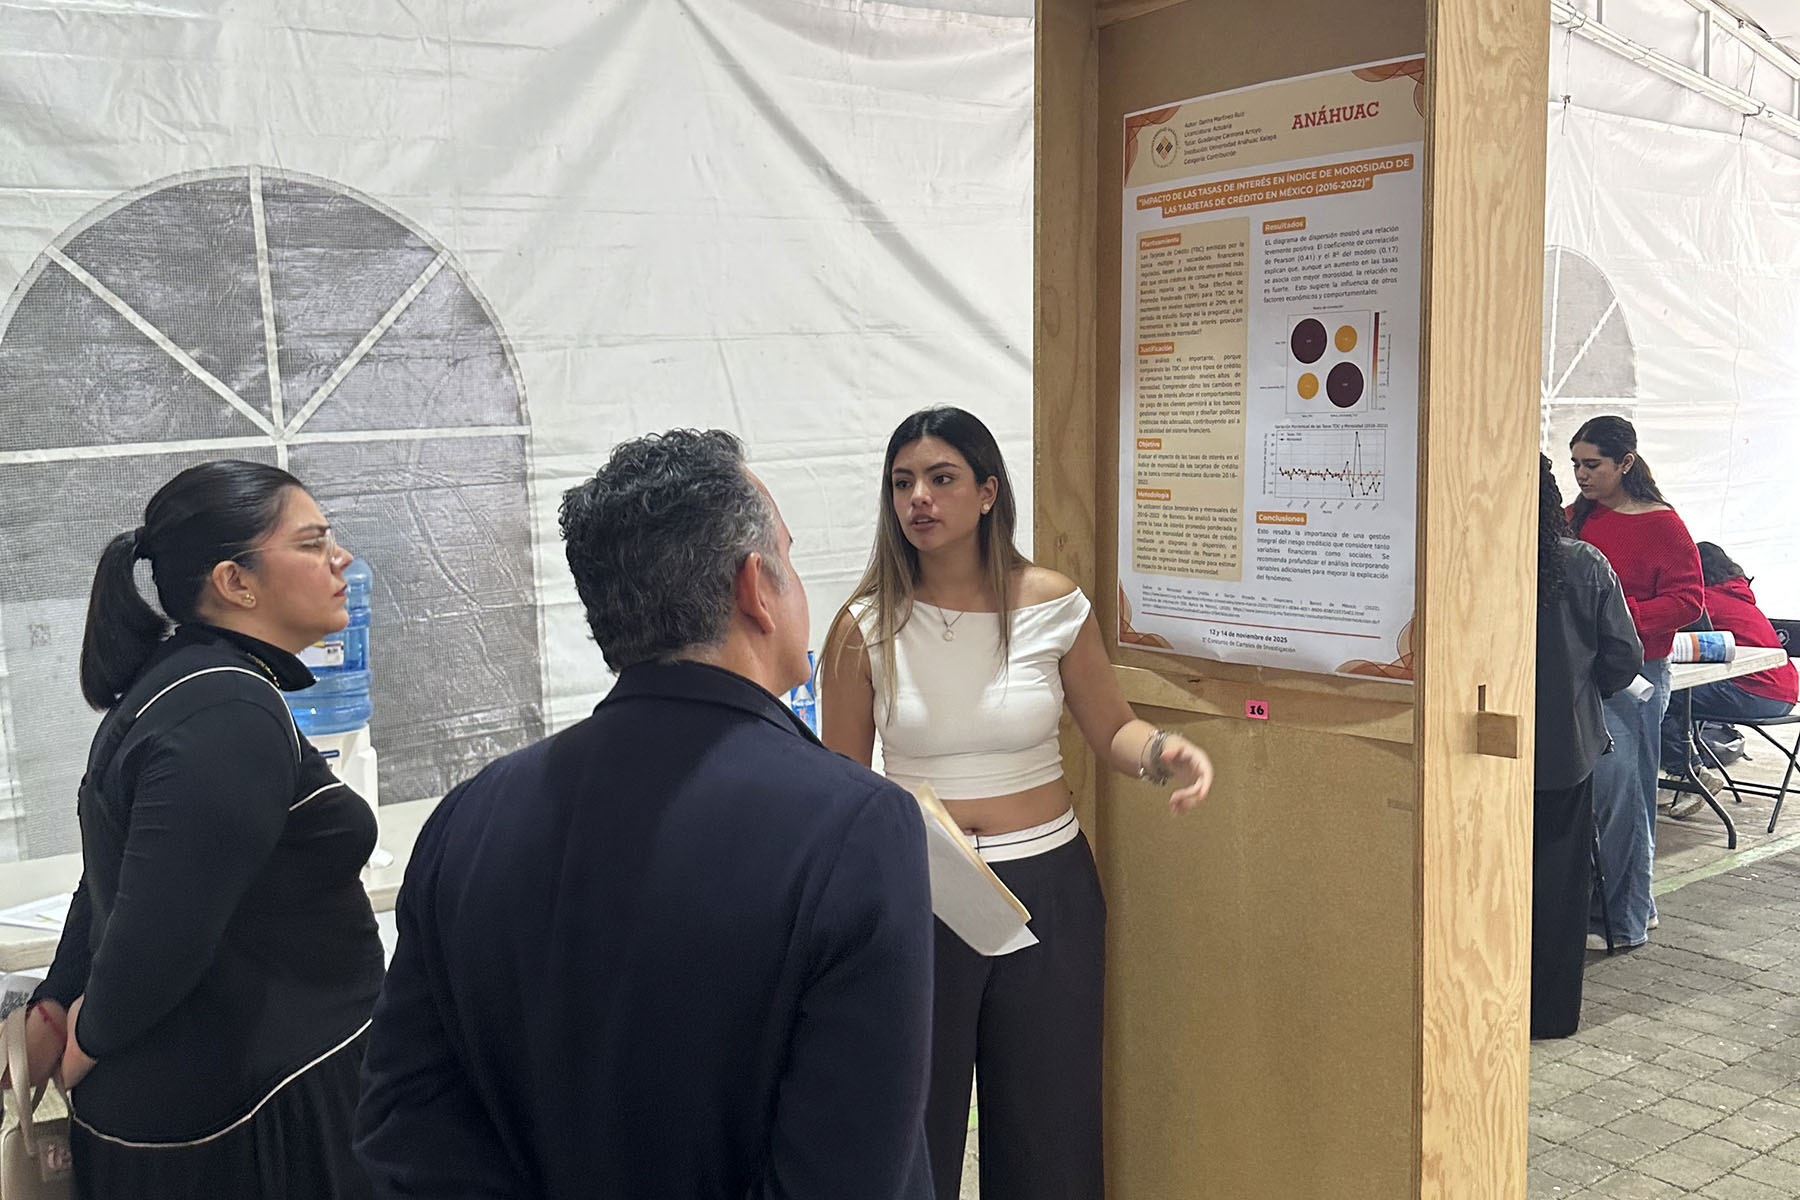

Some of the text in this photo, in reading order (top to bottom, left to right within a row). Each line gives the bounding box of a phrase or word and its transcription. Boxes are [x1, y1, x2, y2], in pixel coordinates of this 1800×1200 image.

[1292, 102, 1379, 130] ANÁHUAC
[1172, 191, 1181, 200] DE
[1183, 189, 1196, 198] LAS
[1198, 185, 1221, 195] TASAS
[1223, 183, 1234, 192] DE
[1236, 178, 1270, 189] INTERÉS
[1273, 176, 1284, 184] EN
[1286, 171, 1316, 182] ÍNDICE
[1319, 169, 1331, 178] DE
[1334, 161, 1393, 175] MOROSIDAD
[1395, 158, 1409, 167] DE
[1164, 205, 1176, 213] LAS
[1178, 199, 1213, 210] TARJETAS
[1214, 198, 1225, 206] DE
[1227, 193, 1263, 204] CRÉDITO
[1265, 191, 1277, 199] EN
[1279, 187, 1313, 197] MÉXICO
[1250, 704, 1264, 715] 16
